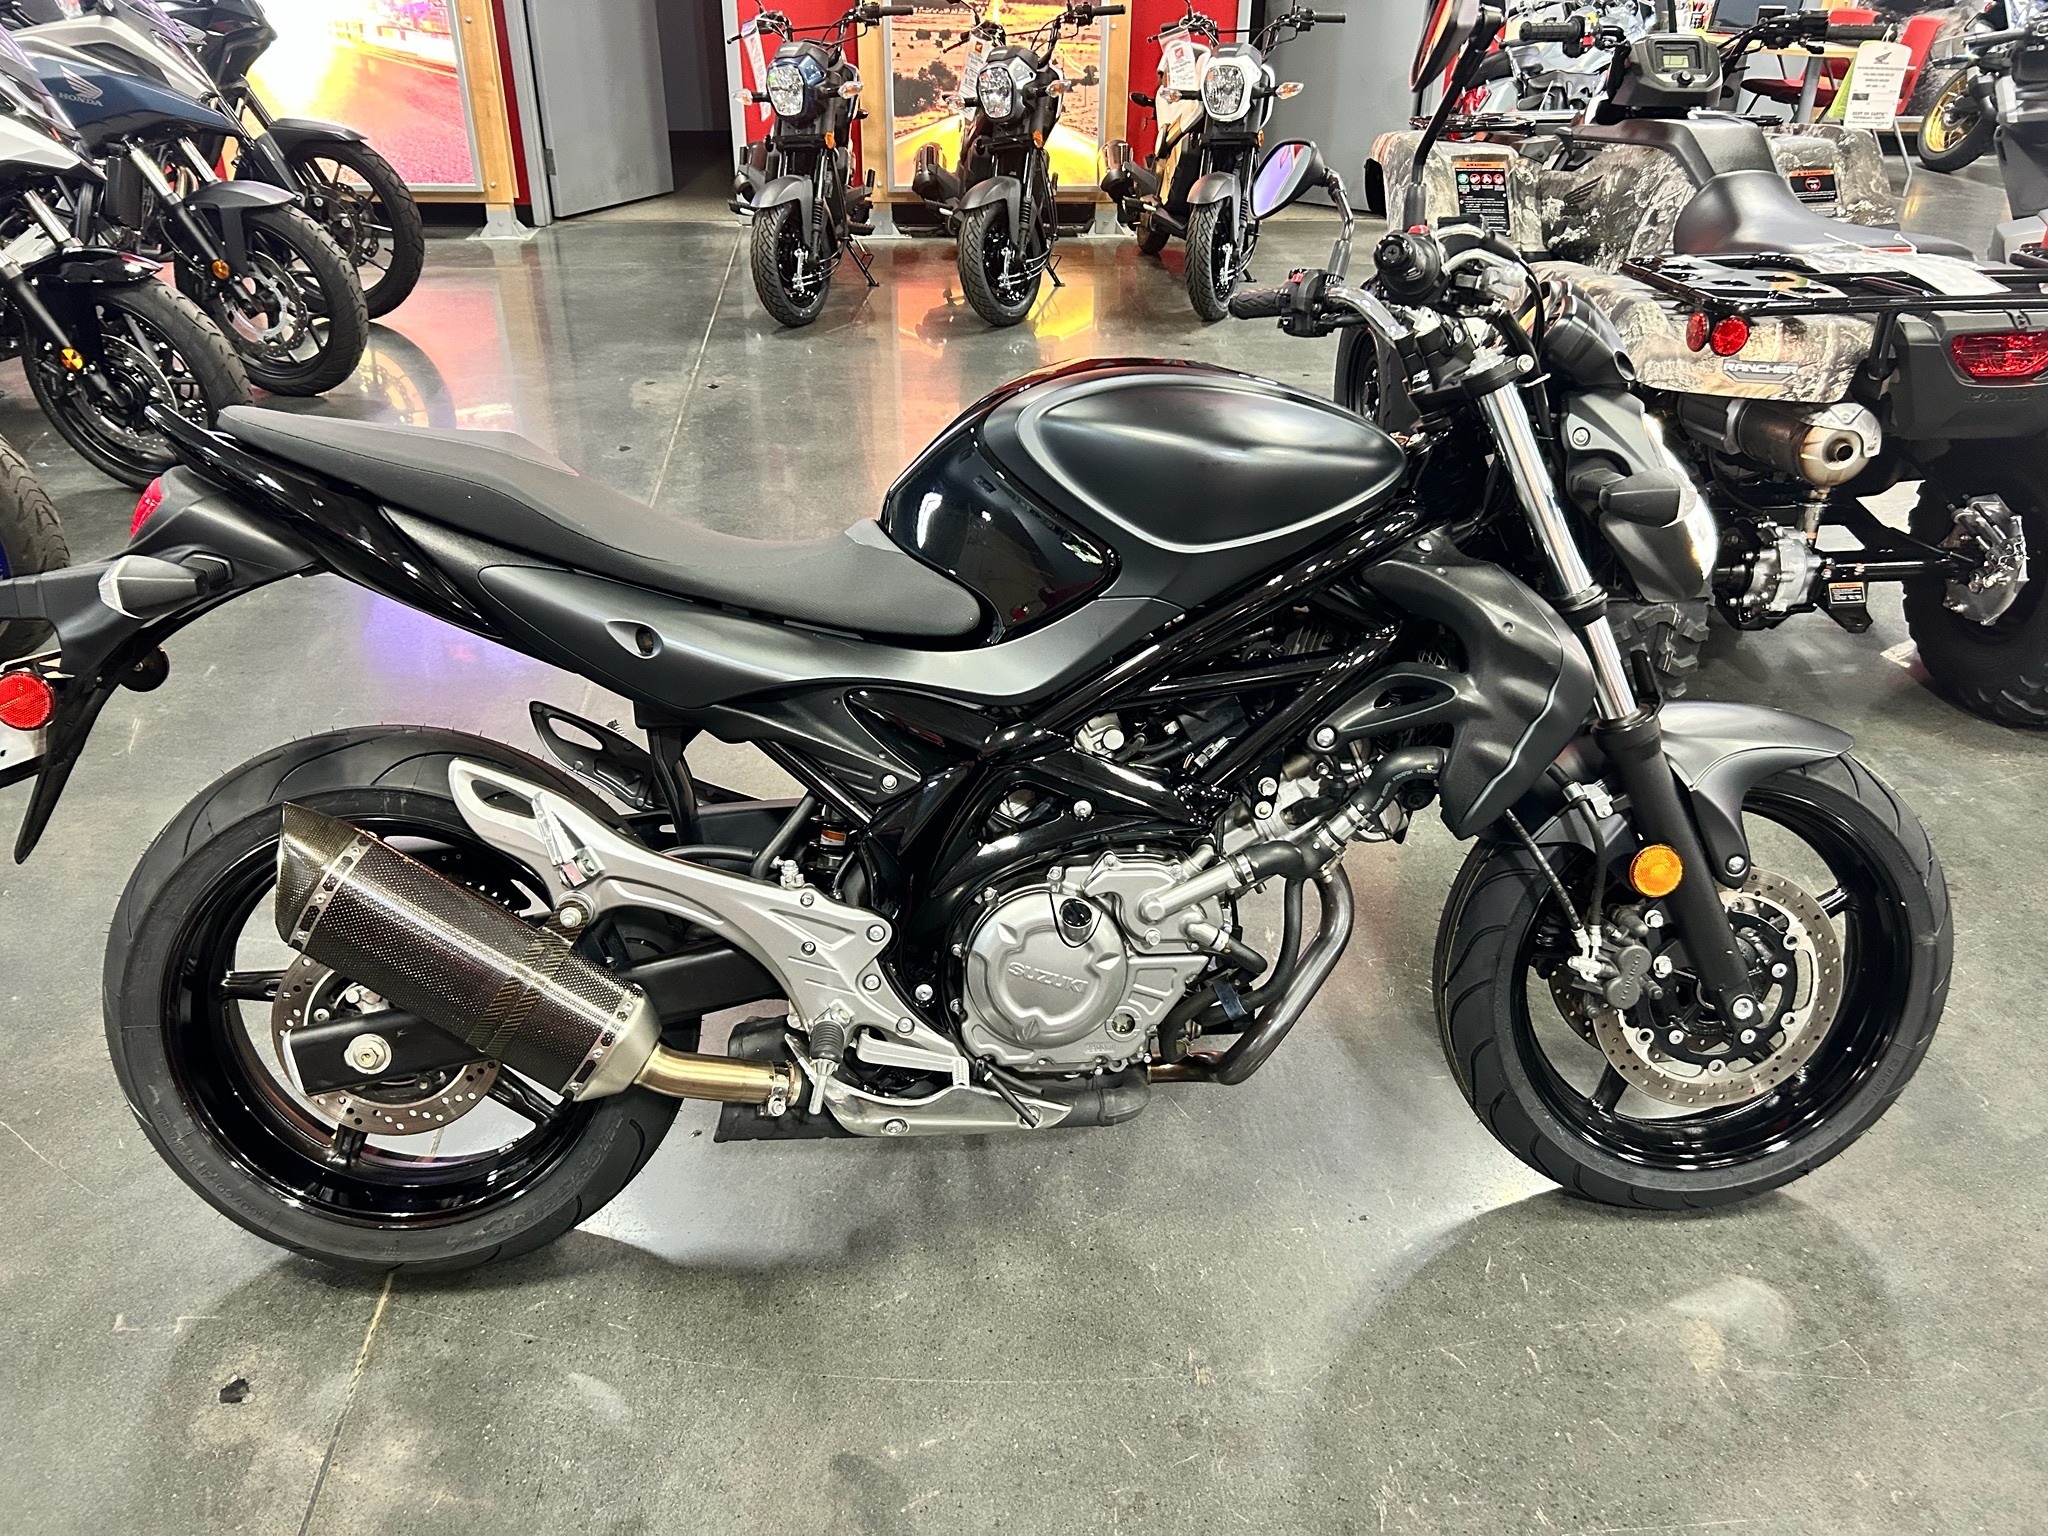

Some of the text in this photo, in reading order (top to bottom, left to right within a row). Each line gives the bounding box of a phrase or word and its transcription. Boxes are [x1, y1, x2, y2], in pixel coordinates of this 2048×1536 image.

[59, 92, 104, 107] HONDA
[1723, 362, 1799, 374] RANCHER
[1008, 962, 1089, 994] SUZUKI
